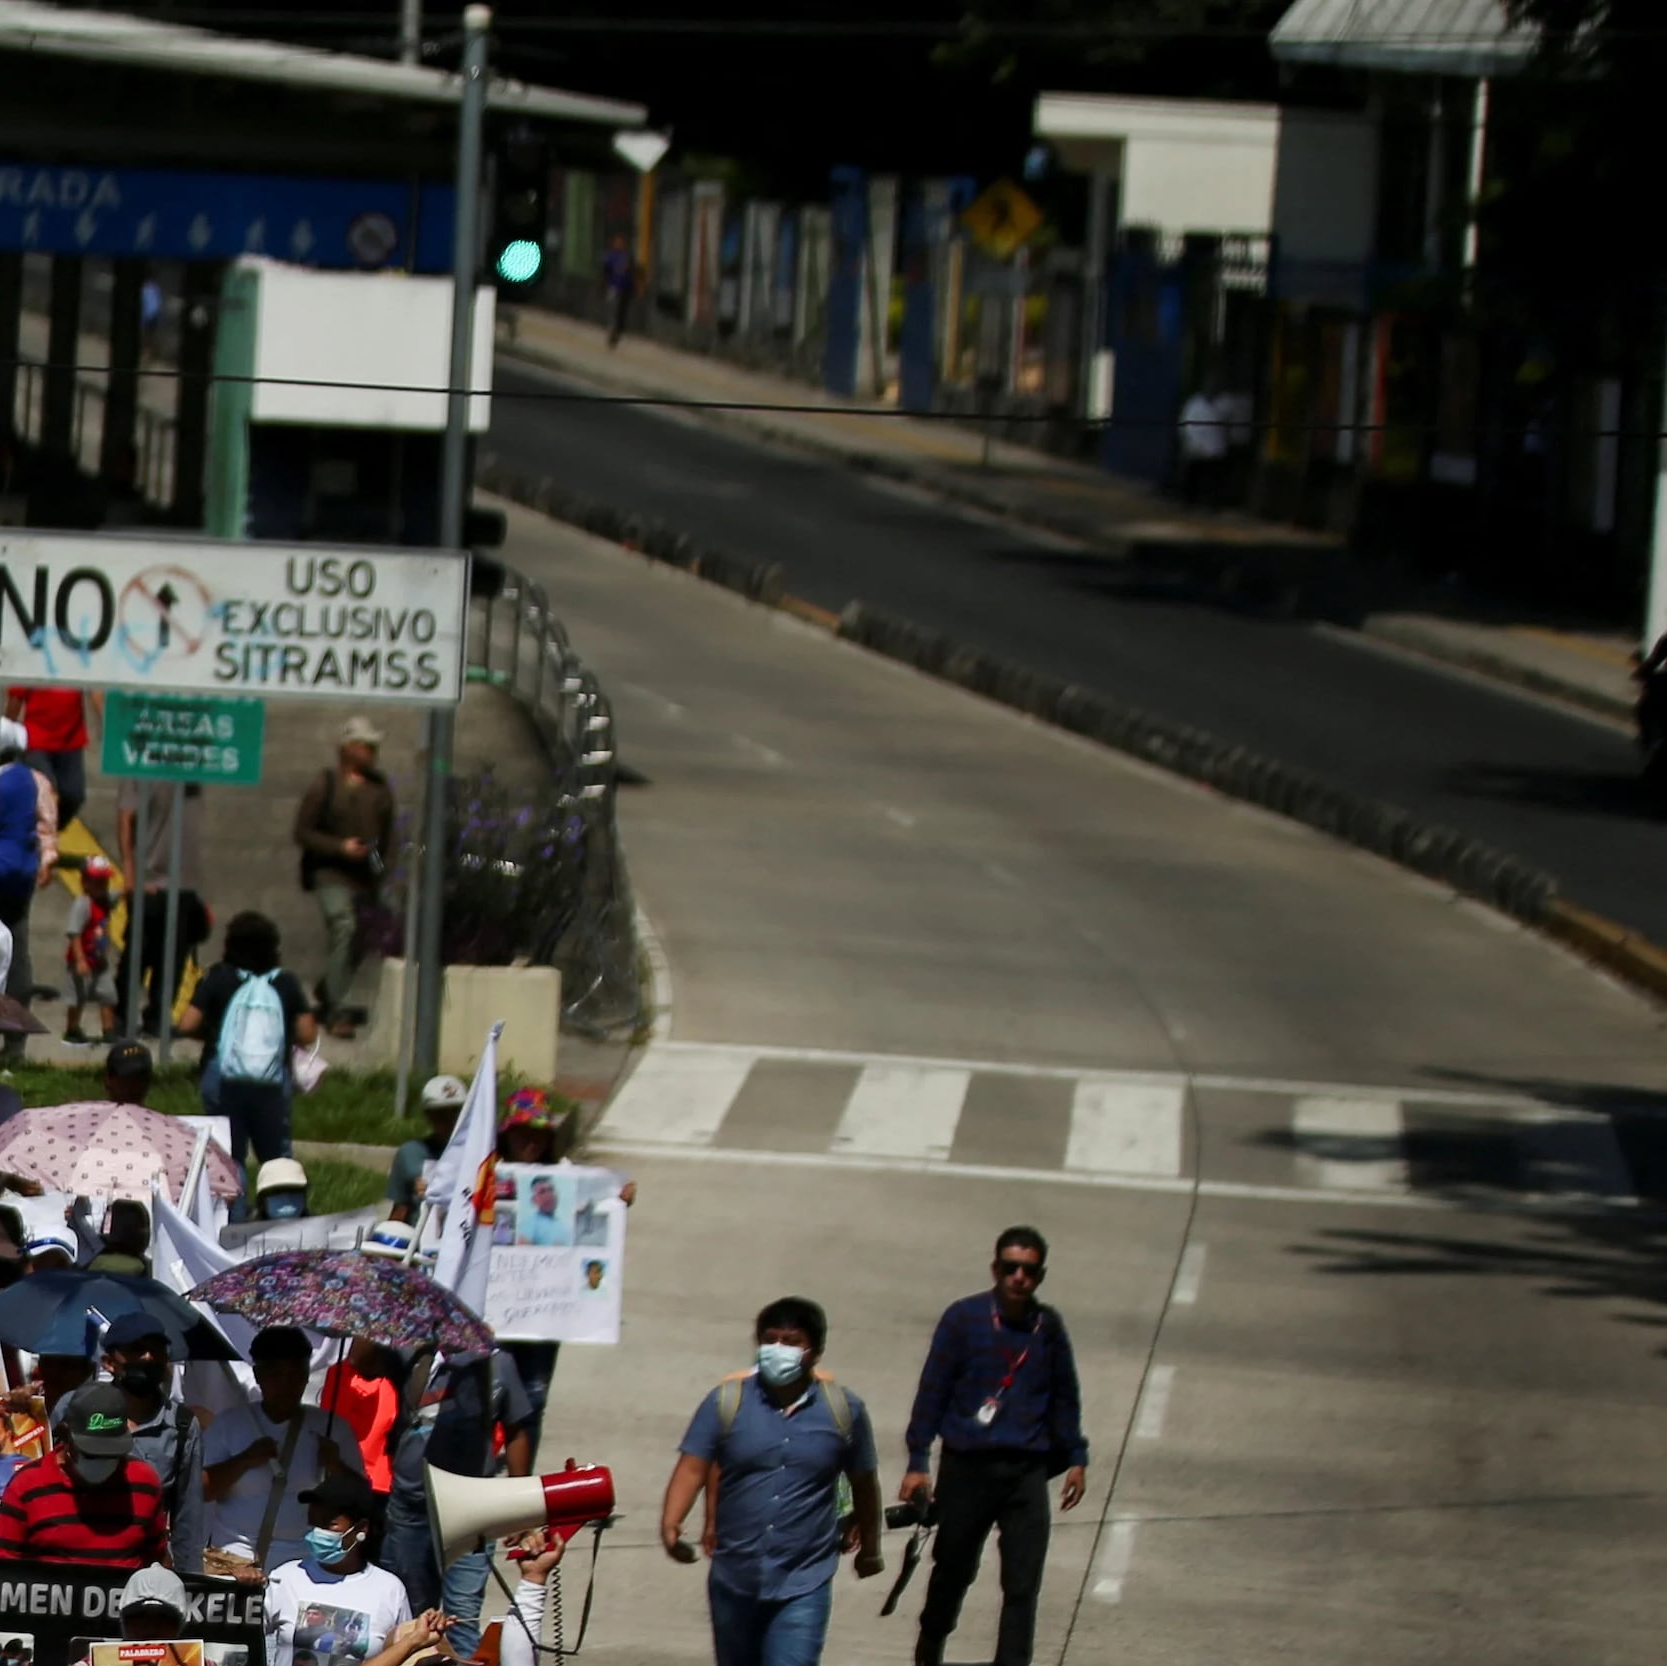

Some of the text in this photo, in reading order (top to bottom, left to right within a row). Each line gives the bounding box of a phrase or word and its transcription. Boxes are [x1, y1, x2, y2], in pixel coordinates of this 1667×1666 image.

[285, 556, 377, 598] USO
[219, 600, 437, 643] EXCLUSIVO
[213, 642, 442, 692] SITRAMSS
[122, 740, 240, 772] VERDES
[82, 1585, 123, 1619] DE
[185, 1592, 265, 1626] KELE
